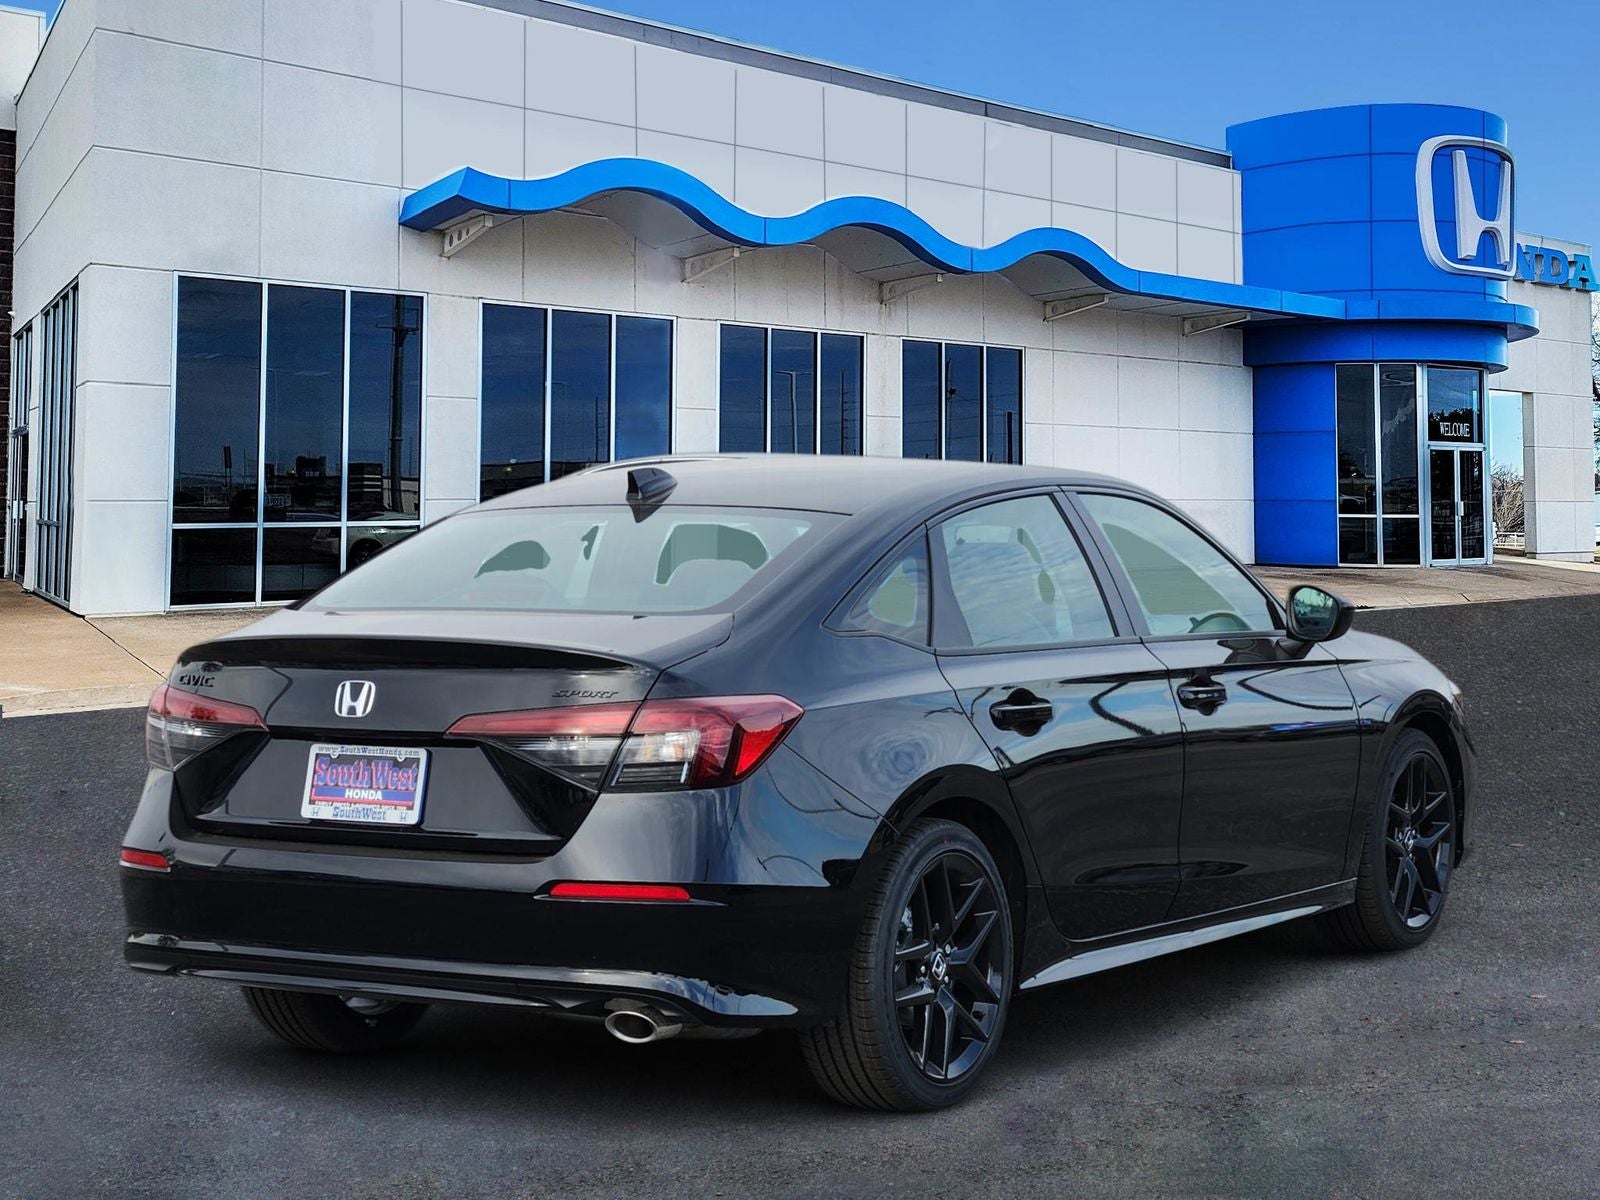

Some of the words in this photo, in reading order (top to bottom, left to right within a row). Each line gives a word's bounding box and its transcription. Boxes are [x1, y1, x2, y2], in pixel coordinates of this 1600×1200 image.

[1516, 242, 1600, 291] NDA
[1439, 422, 1471, 437] WELCOME
[179, 674, 215, 688] CIVIC
[551, 690, 619, 698] SPORT
[344, 788, 383, 800] HONDA
